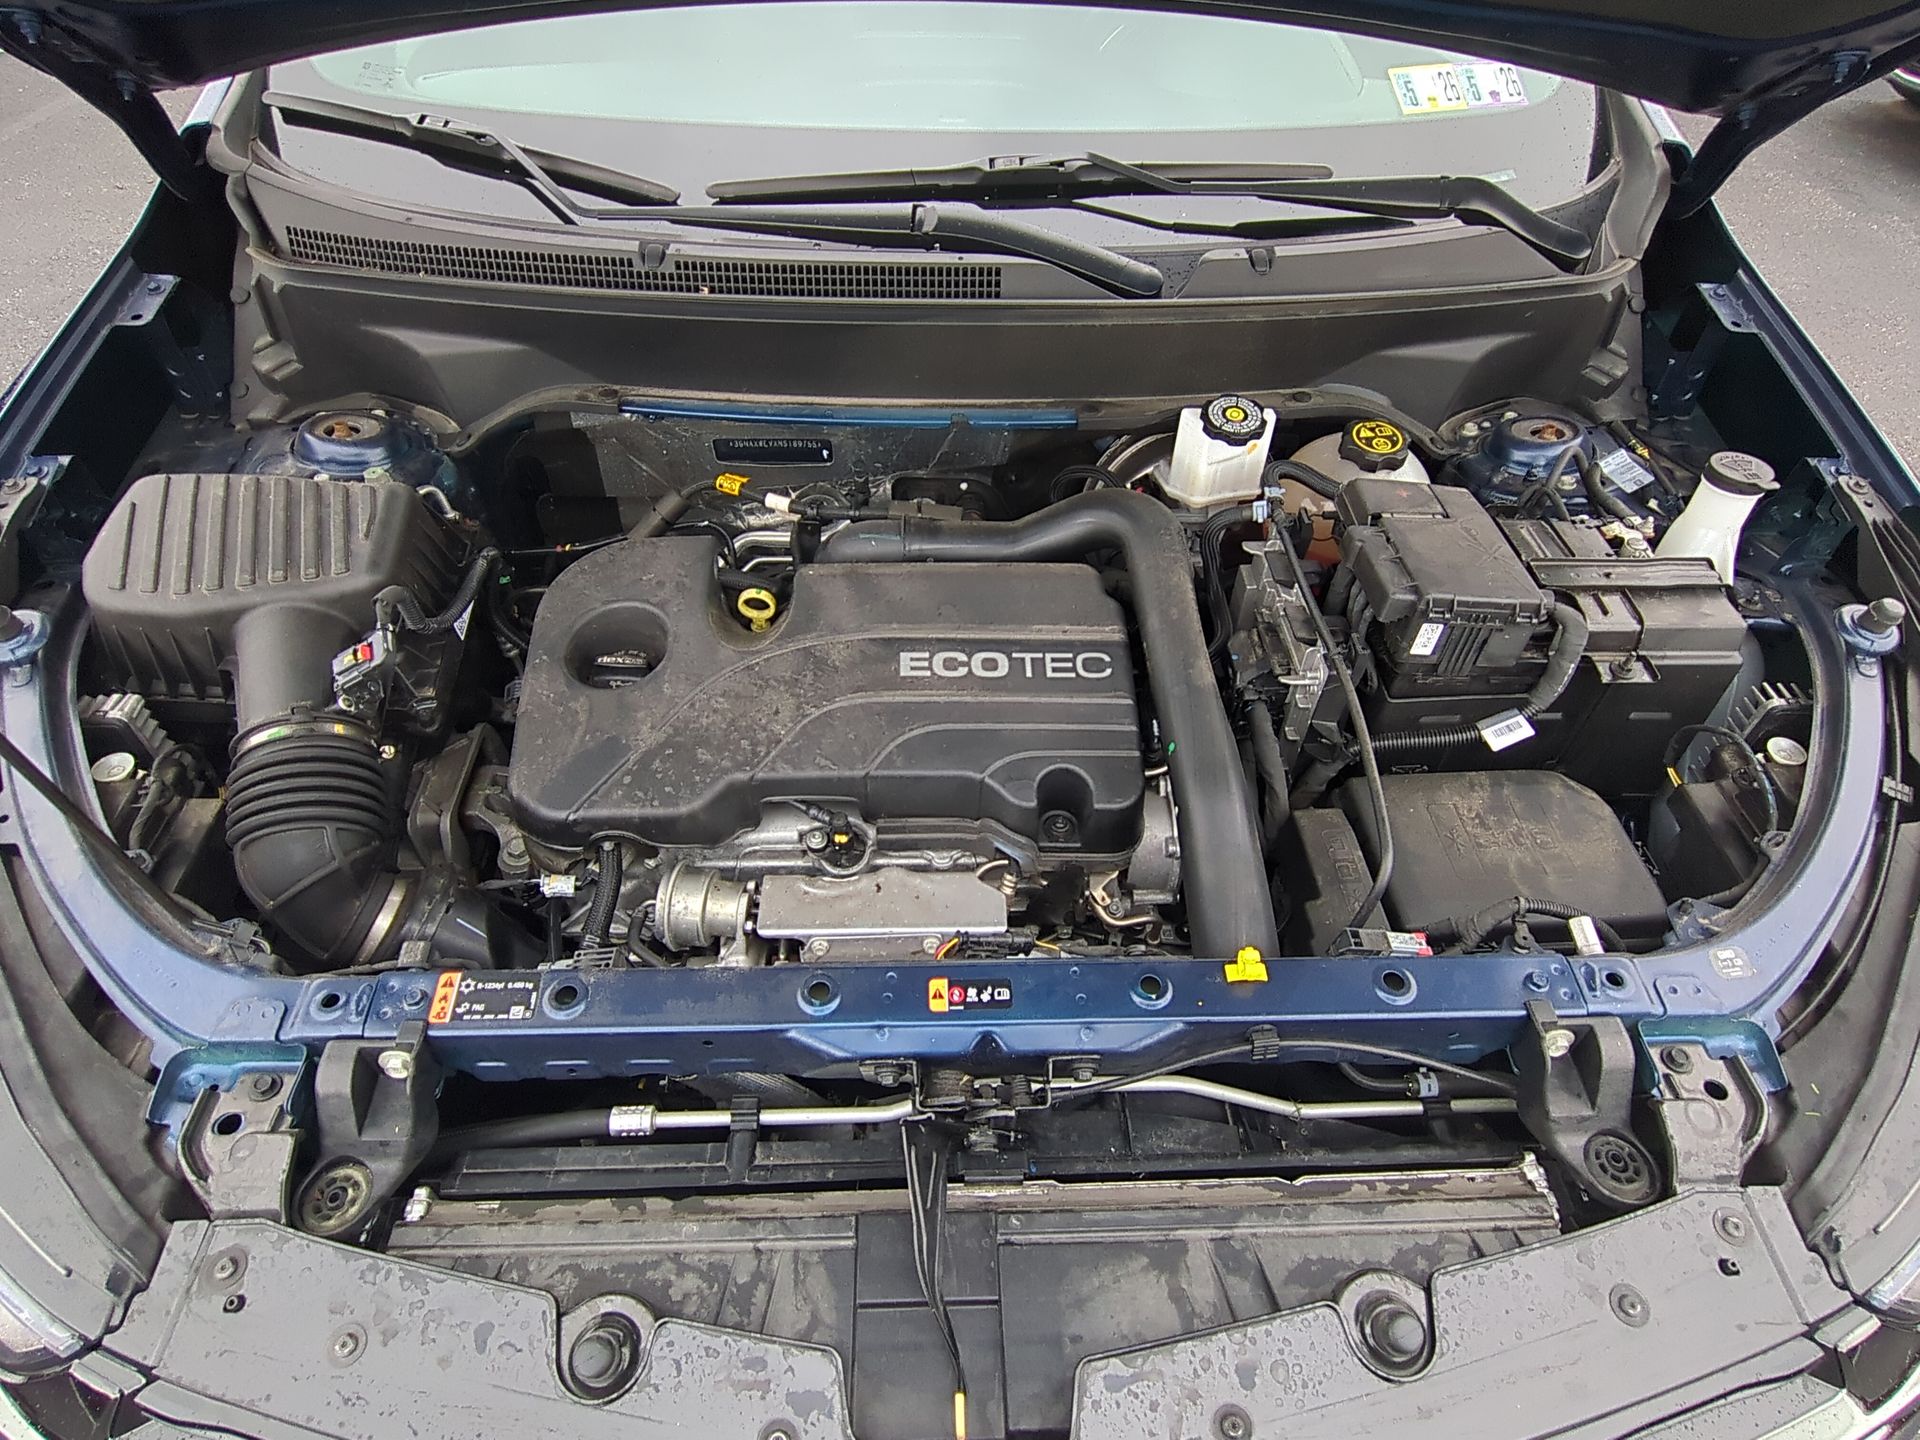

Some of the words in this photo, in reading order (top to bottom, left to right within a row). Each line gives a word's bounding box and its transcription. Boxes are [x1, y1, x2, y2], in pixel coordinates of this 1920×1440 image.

[1403, 80, 1419, 106] 5
[1438, 71, 1461, 102] 26
[1466, 75, 1482, 102] 5
[1500, 67, 1522, 97] 26
[899, 651, 1113, 678] ECOTEC
[471, 1003, 485, 1011] PAG
